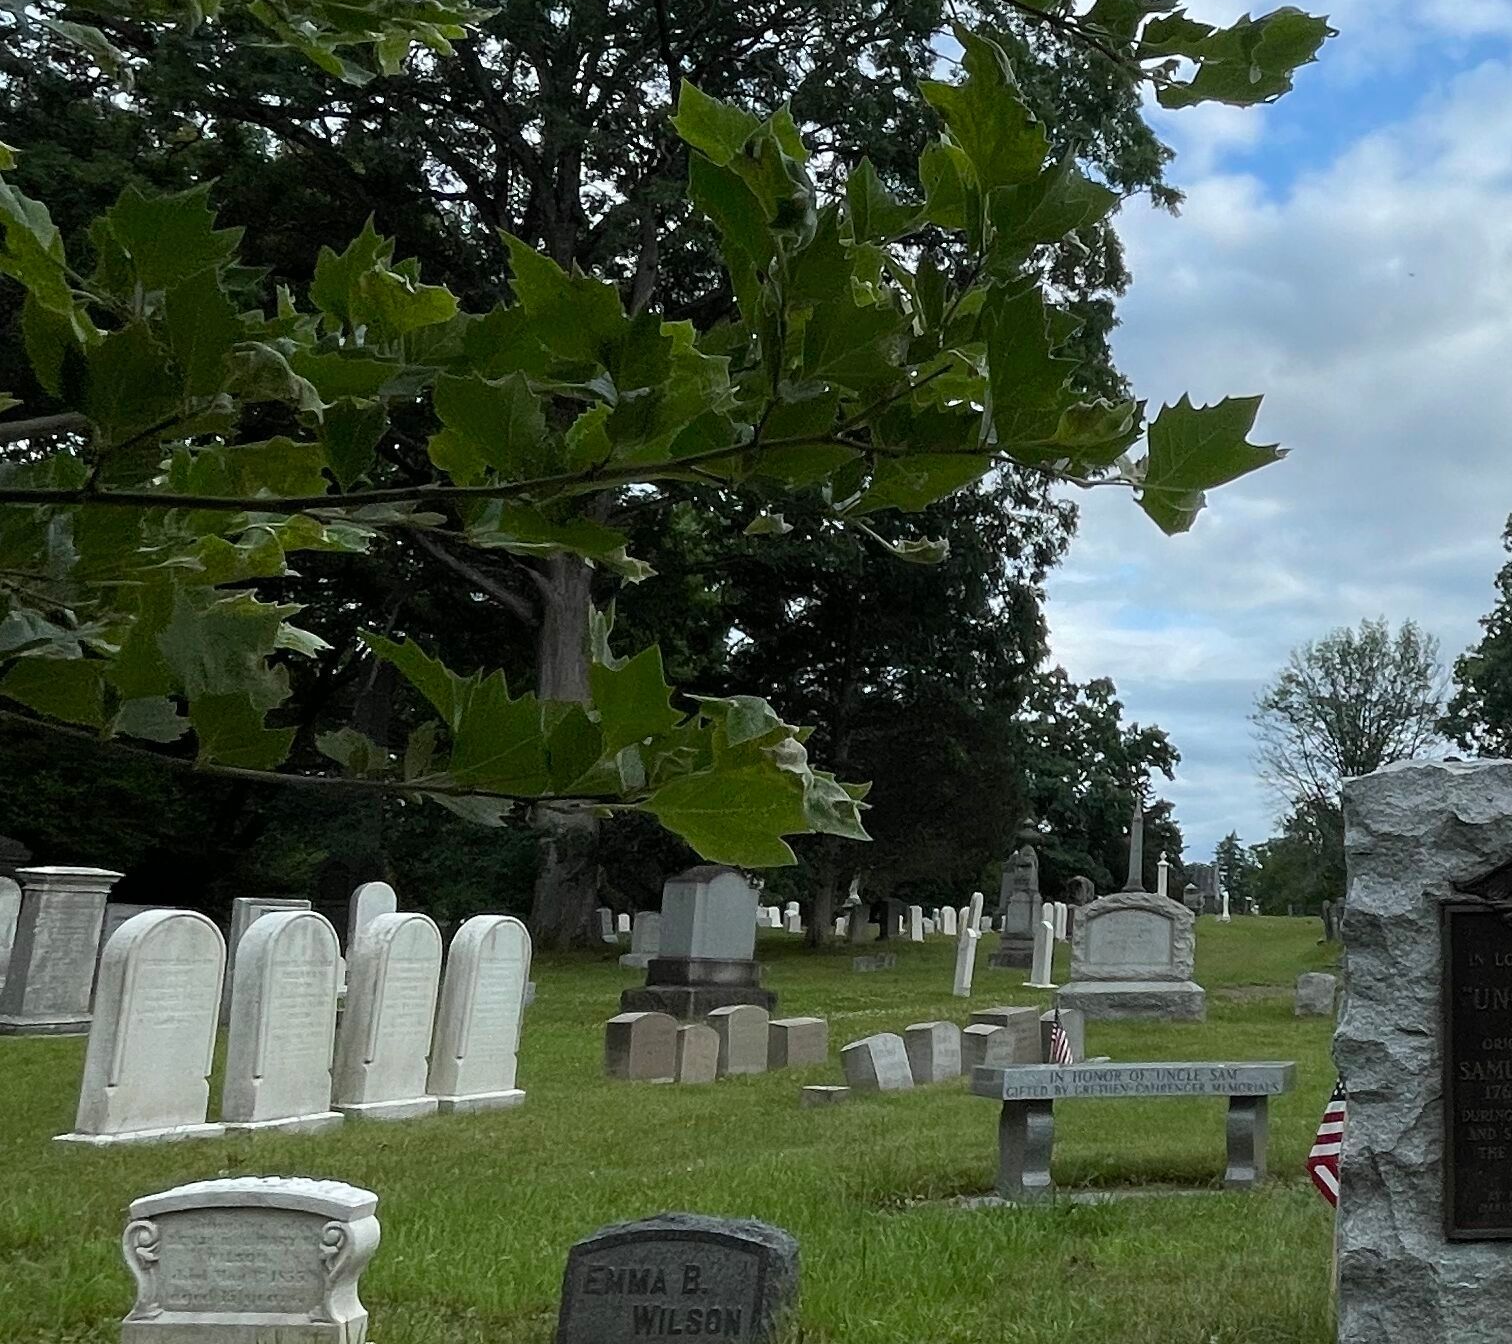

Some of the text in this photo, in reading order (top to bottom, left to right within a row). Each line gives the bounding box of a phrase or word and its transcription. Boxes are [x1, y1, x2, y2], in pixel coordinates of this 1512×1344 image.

[1468, 952, 1485, 966] IN
[1049, 1068, 1239, 1084] IN HONOR OF UNCLE SAM
[1006, 1086, 1048, 1097] GIFTED
[1054, 1085, 1069, 1095] BY
[1211, 1082, 1281, 1093] MEMORIALS
[1467, 1127, 1497, 1141] AND
[1477, 1146, 1506, 1160] THE
[583, 1263, 708, 1295] EMMA B.
[633, 1305, 742, 1335] WILSON
